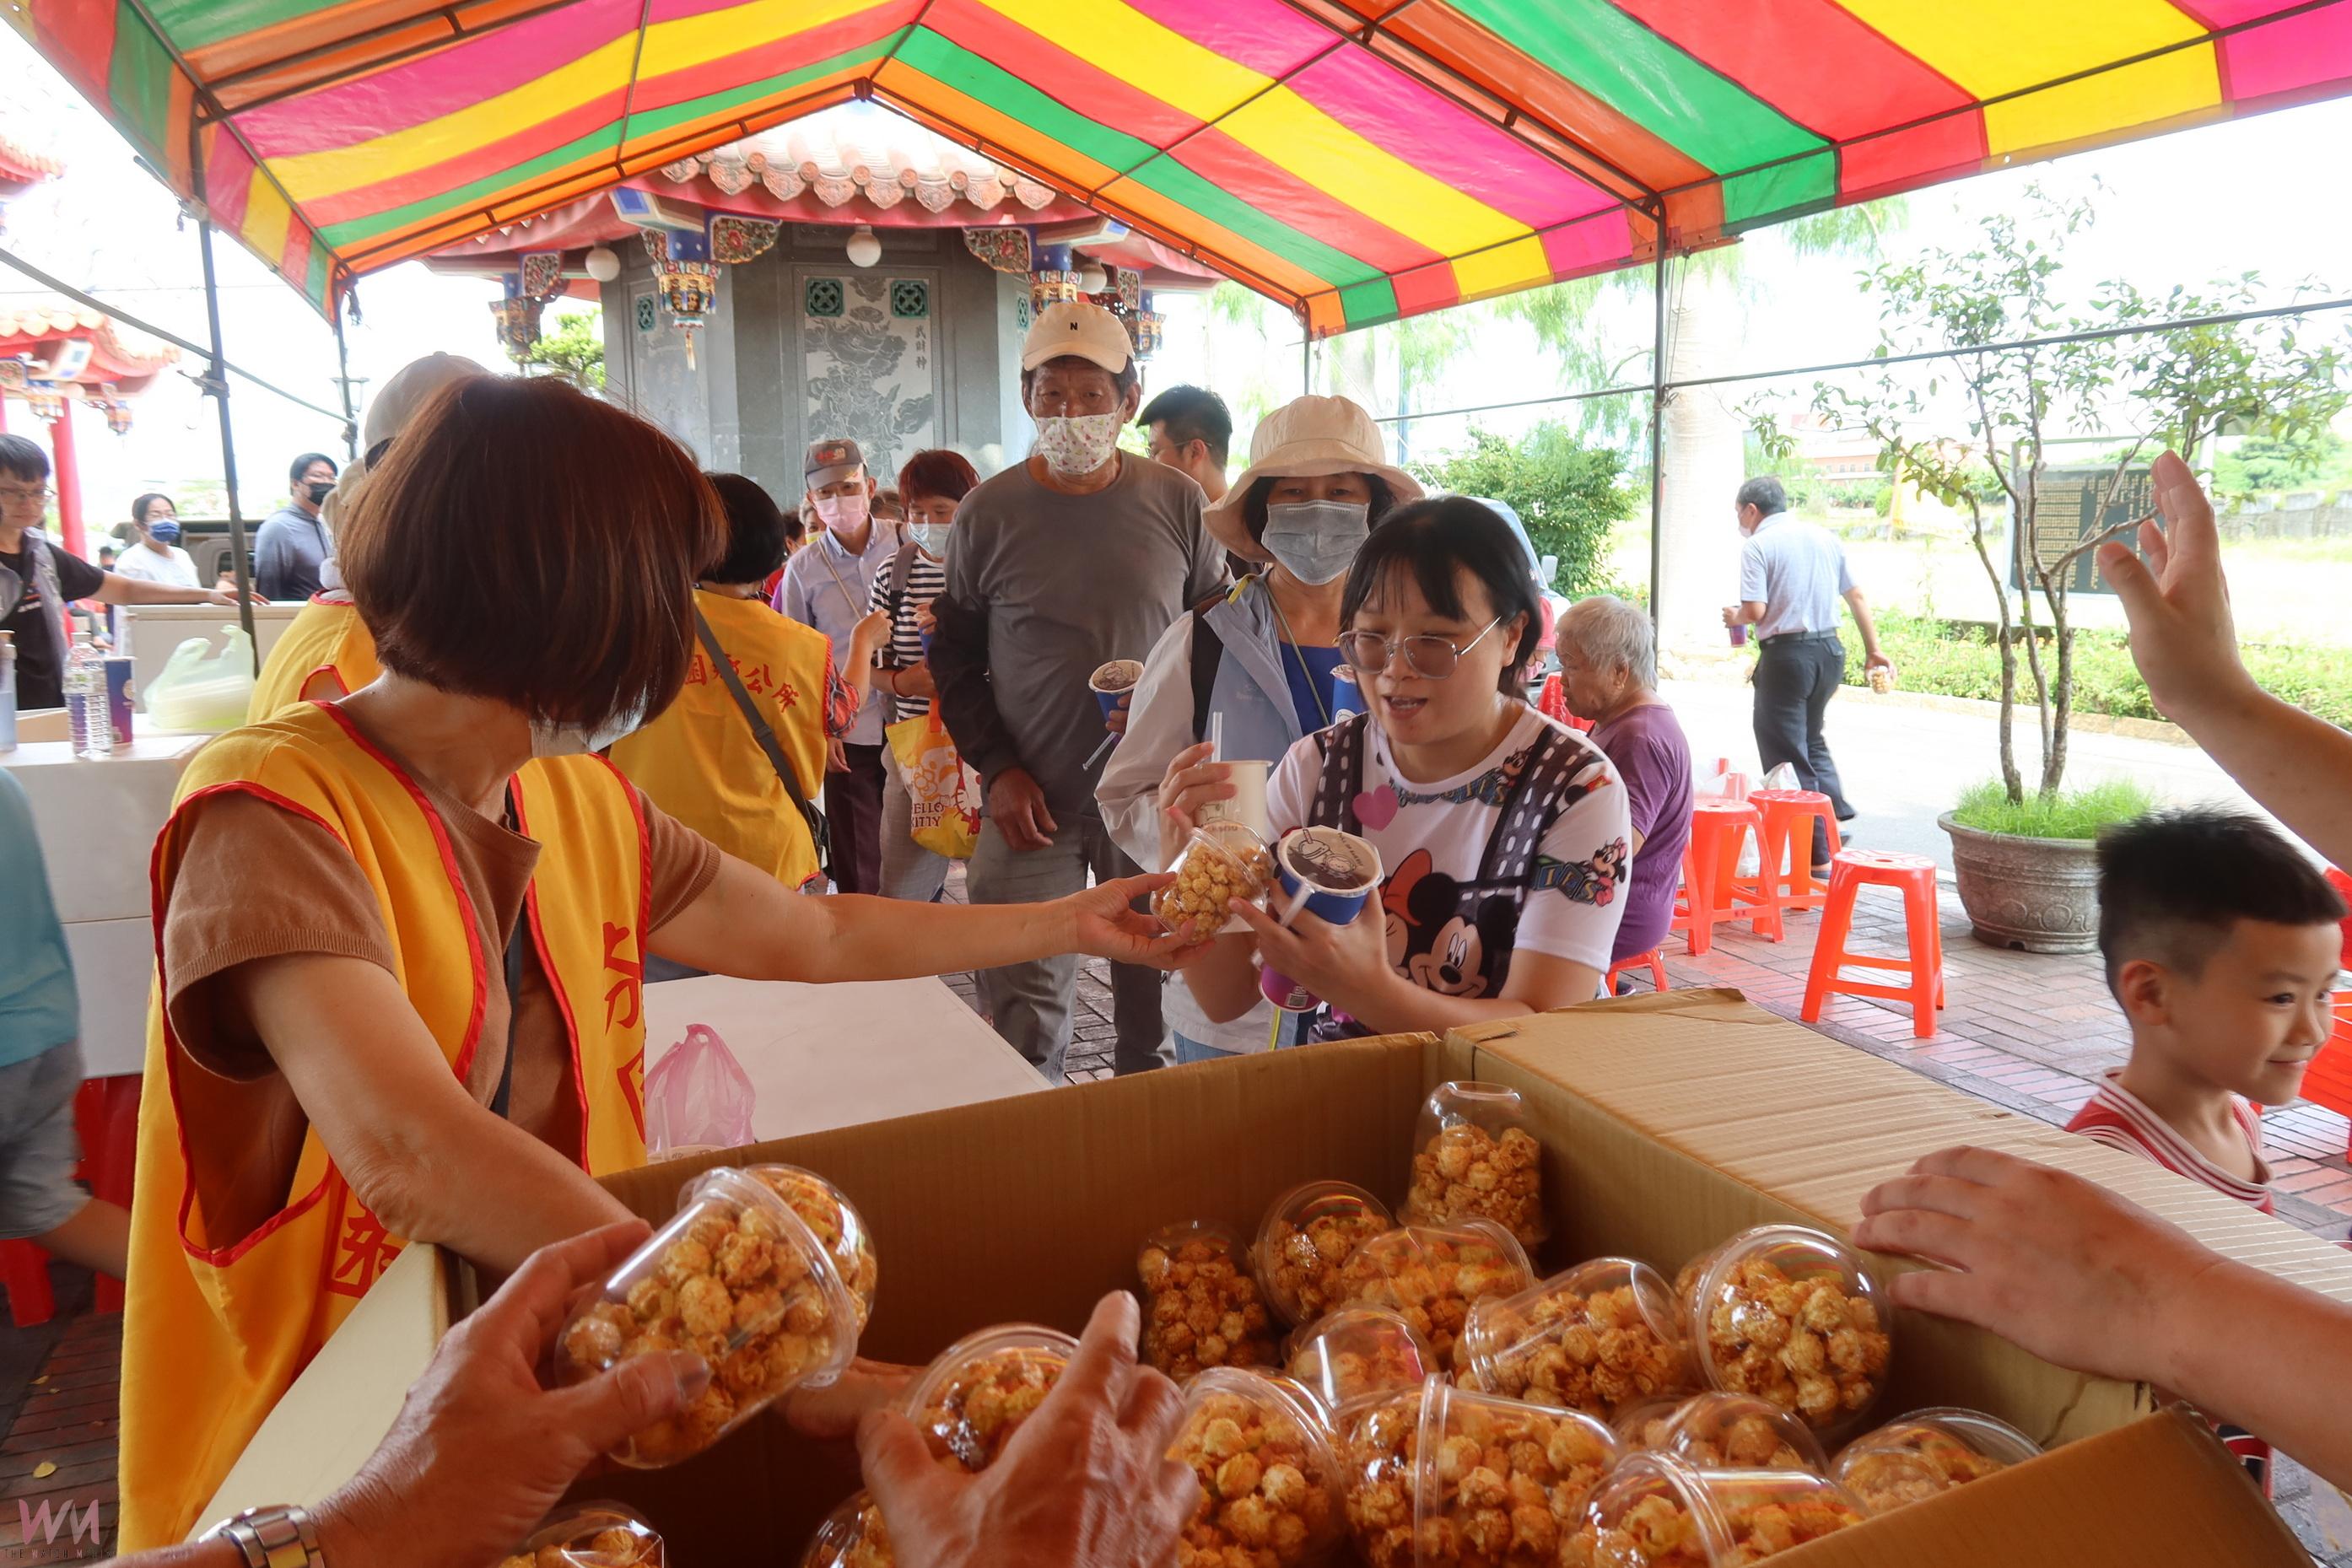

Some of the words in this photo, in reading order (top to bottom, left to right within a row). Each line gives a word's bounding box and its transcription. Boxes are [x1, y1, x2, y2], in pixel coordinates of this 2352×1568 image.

[1070, 322, 1078, 331] N
[915, 325, 926, 371] 武財神
[911, 801, 944, 815] ELLO
[911, 816, 941, 828] ITTY
